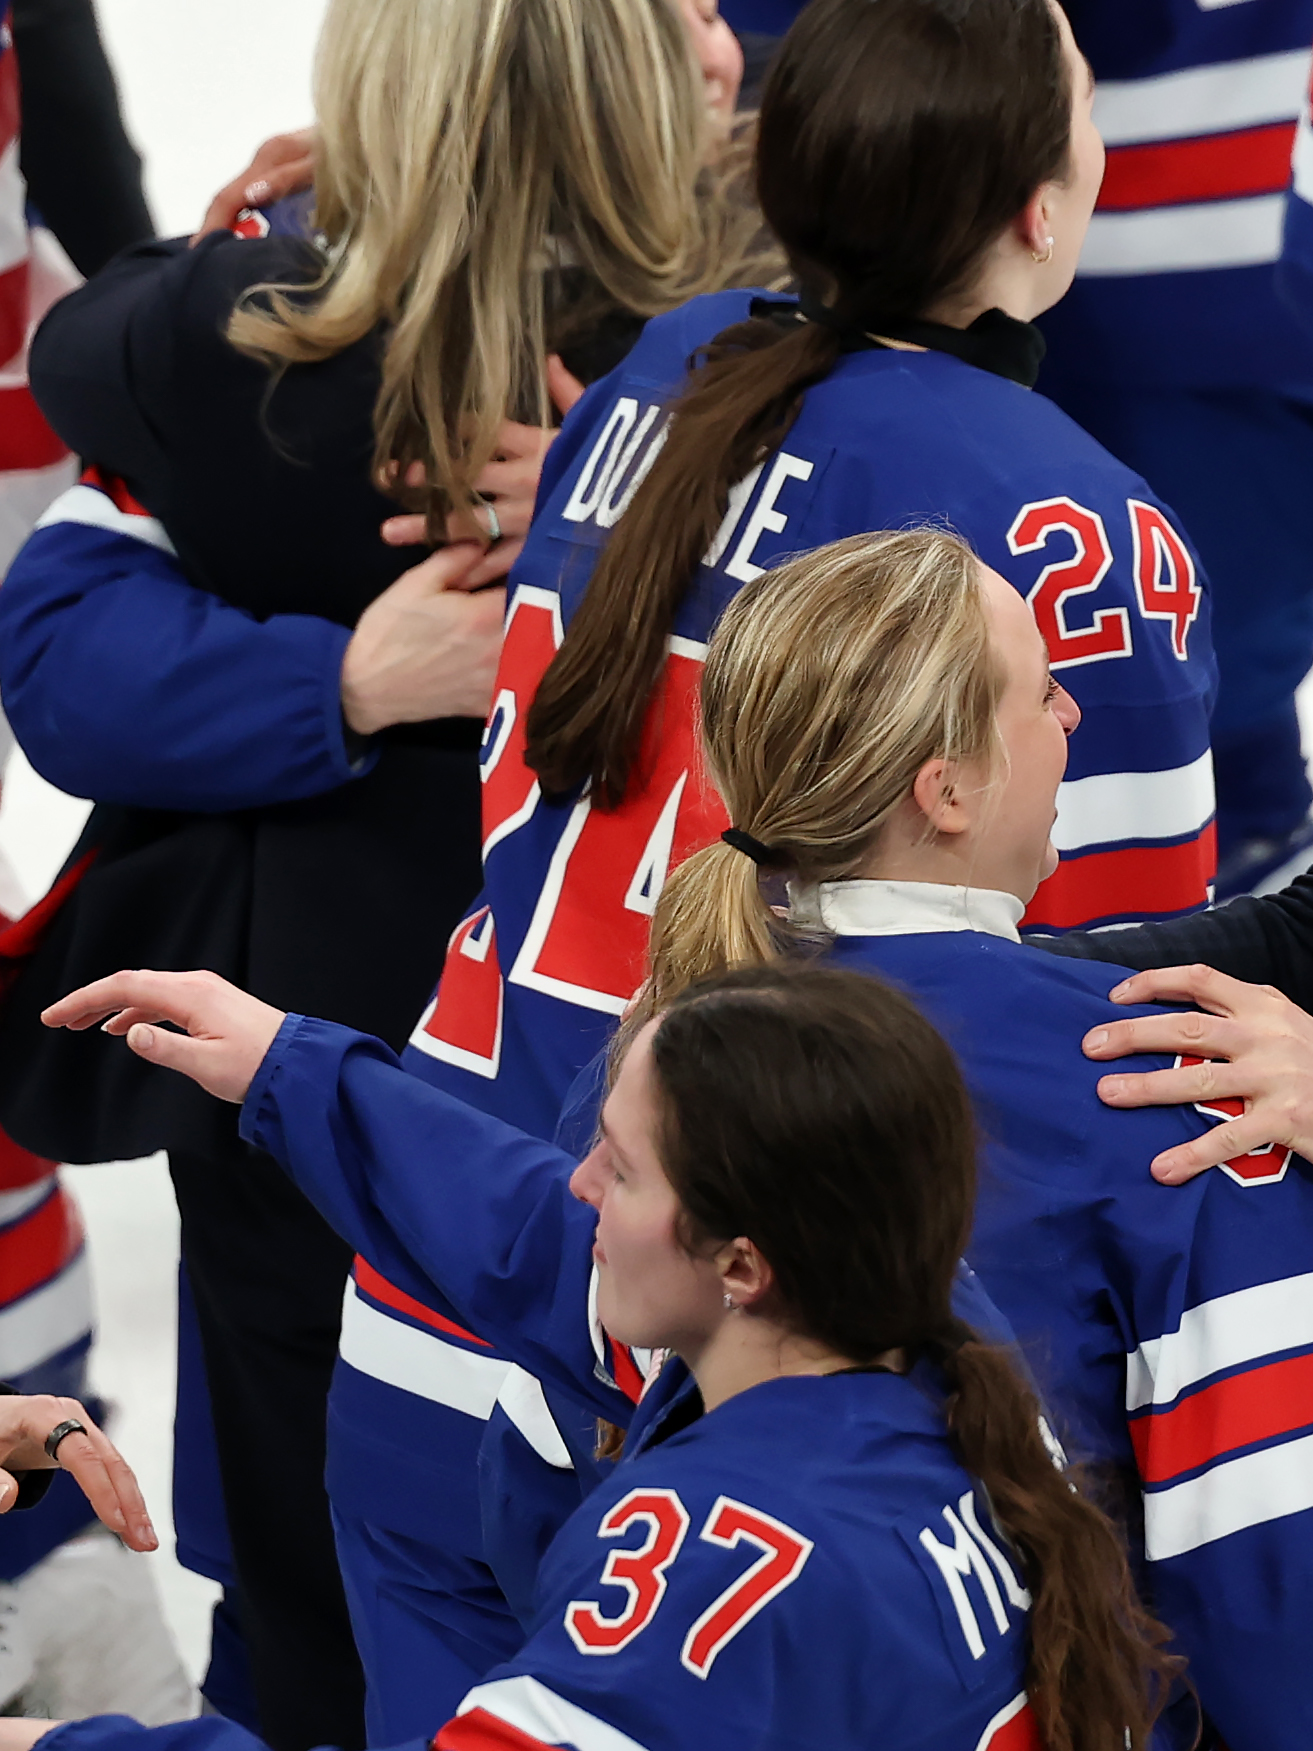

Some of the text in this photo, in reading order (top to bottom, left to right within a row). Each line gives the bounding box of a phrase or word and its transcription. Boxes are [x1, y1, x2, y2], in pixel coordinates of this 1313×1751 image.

[561, 396, 815, 584] DUE
[1005, 495, 1203, 671] 24
[563, 1487, 815, 1681] 37
